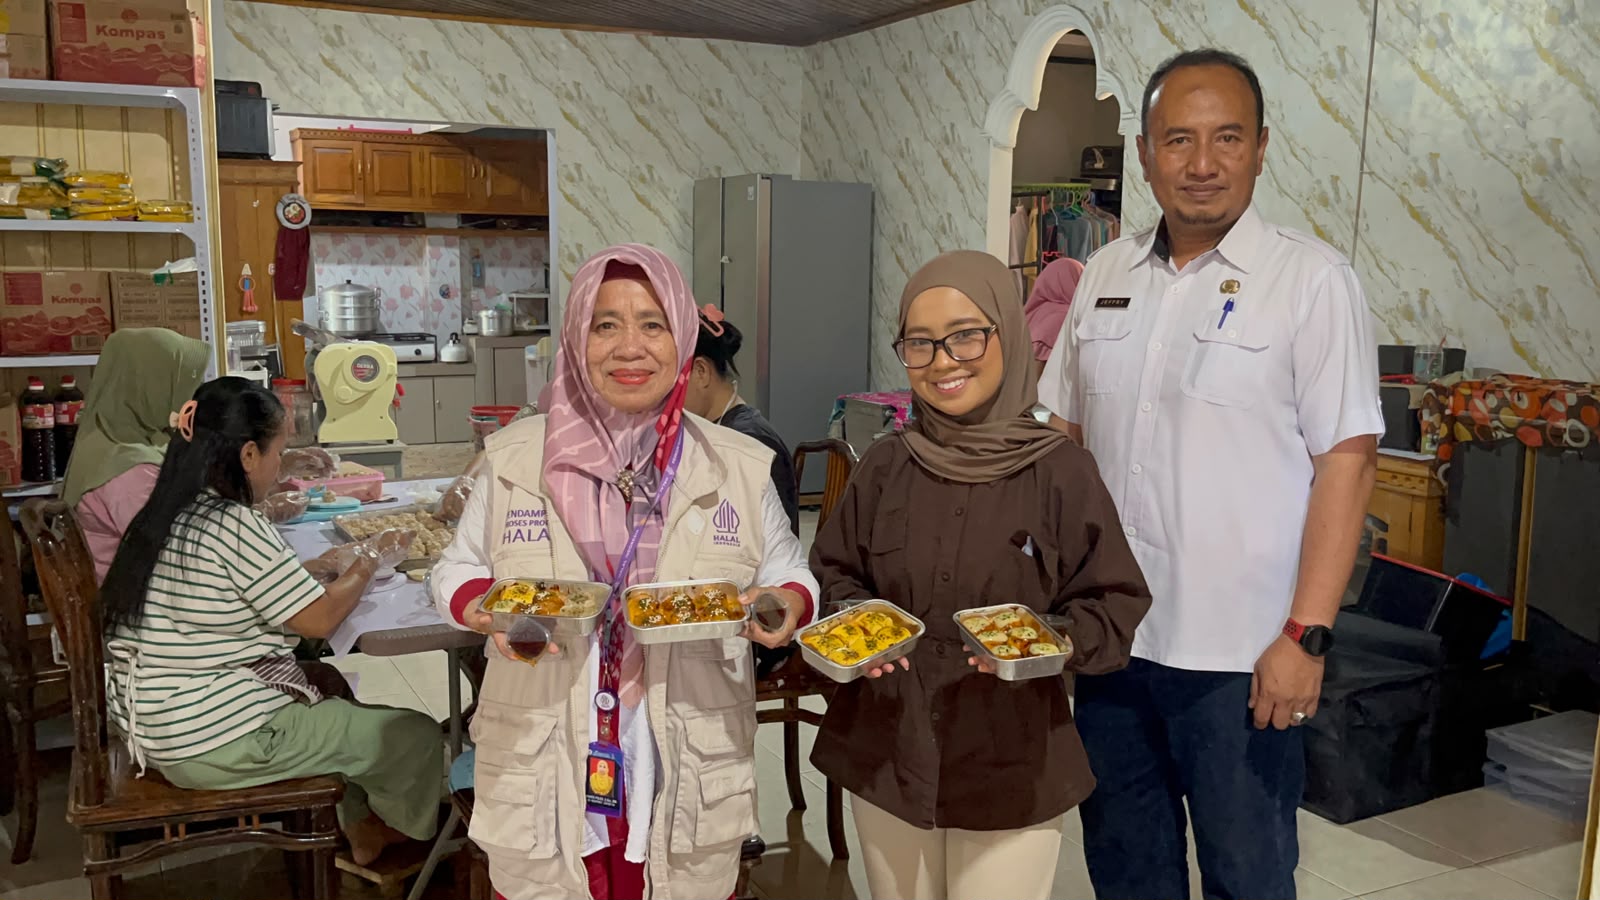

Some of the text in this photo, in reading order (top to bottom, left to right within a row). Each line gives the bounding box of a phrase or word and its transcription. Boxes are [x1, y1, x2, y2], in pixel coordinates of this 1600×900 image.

[95, 24, 166, 40] Kompas
[51, 295, 102, 306] Kompas
[713, 535, 741, 544] HALAL
